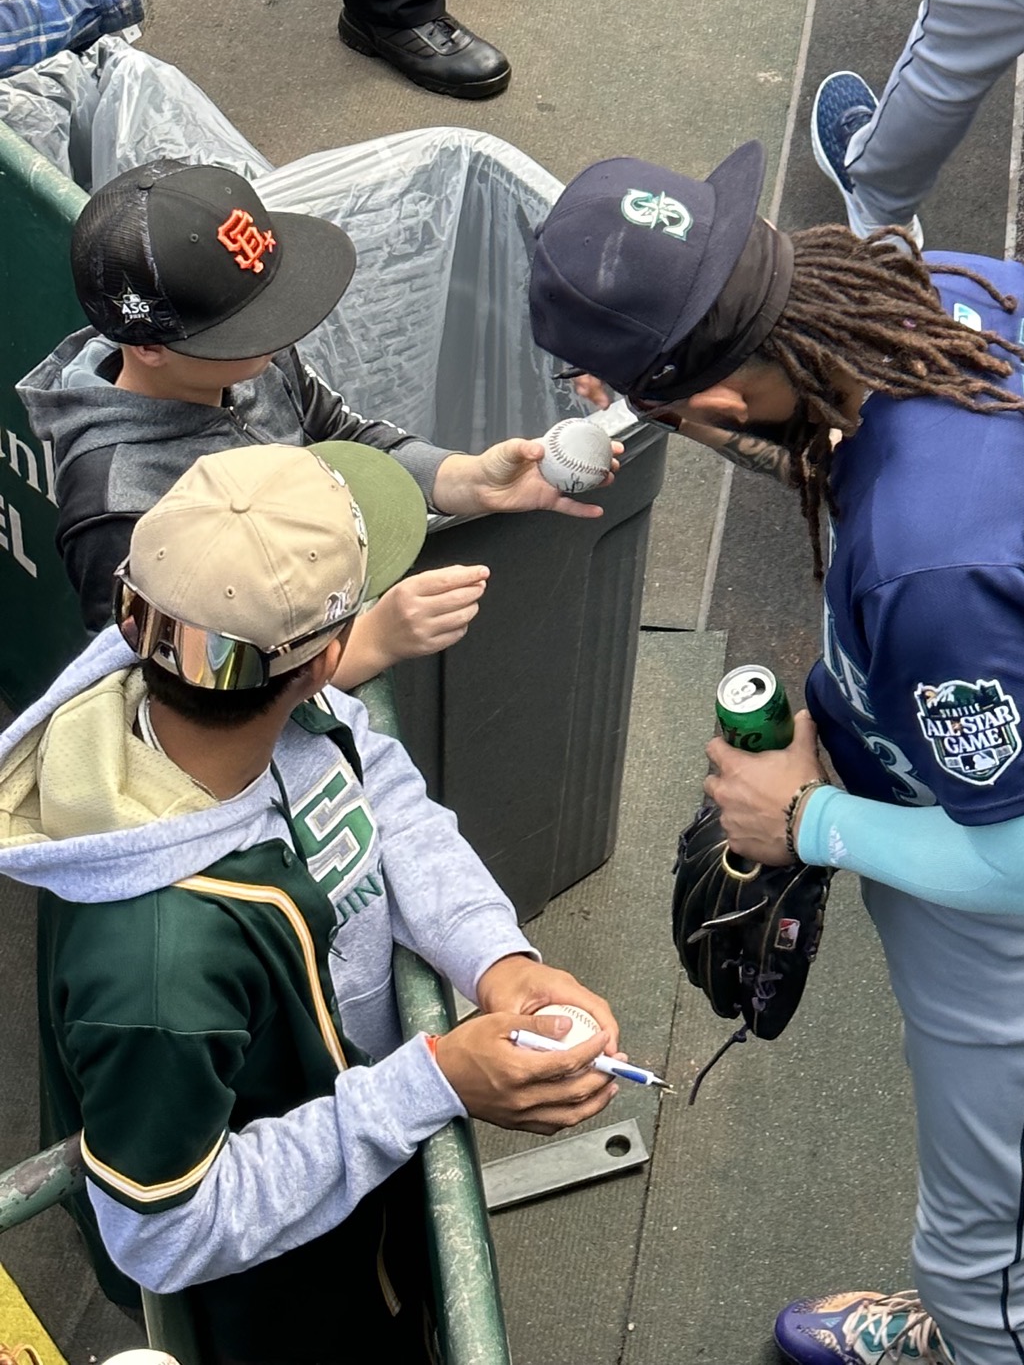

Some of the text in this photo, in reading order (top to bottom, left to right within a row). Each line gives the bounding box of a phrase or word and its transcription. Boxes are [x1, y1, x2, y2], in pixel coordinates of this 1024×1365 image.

[121, 301, 150, 315] ASG
[939, 702, 981, 718] SEATTLE
[943, 728, 1003, 754] GAME
